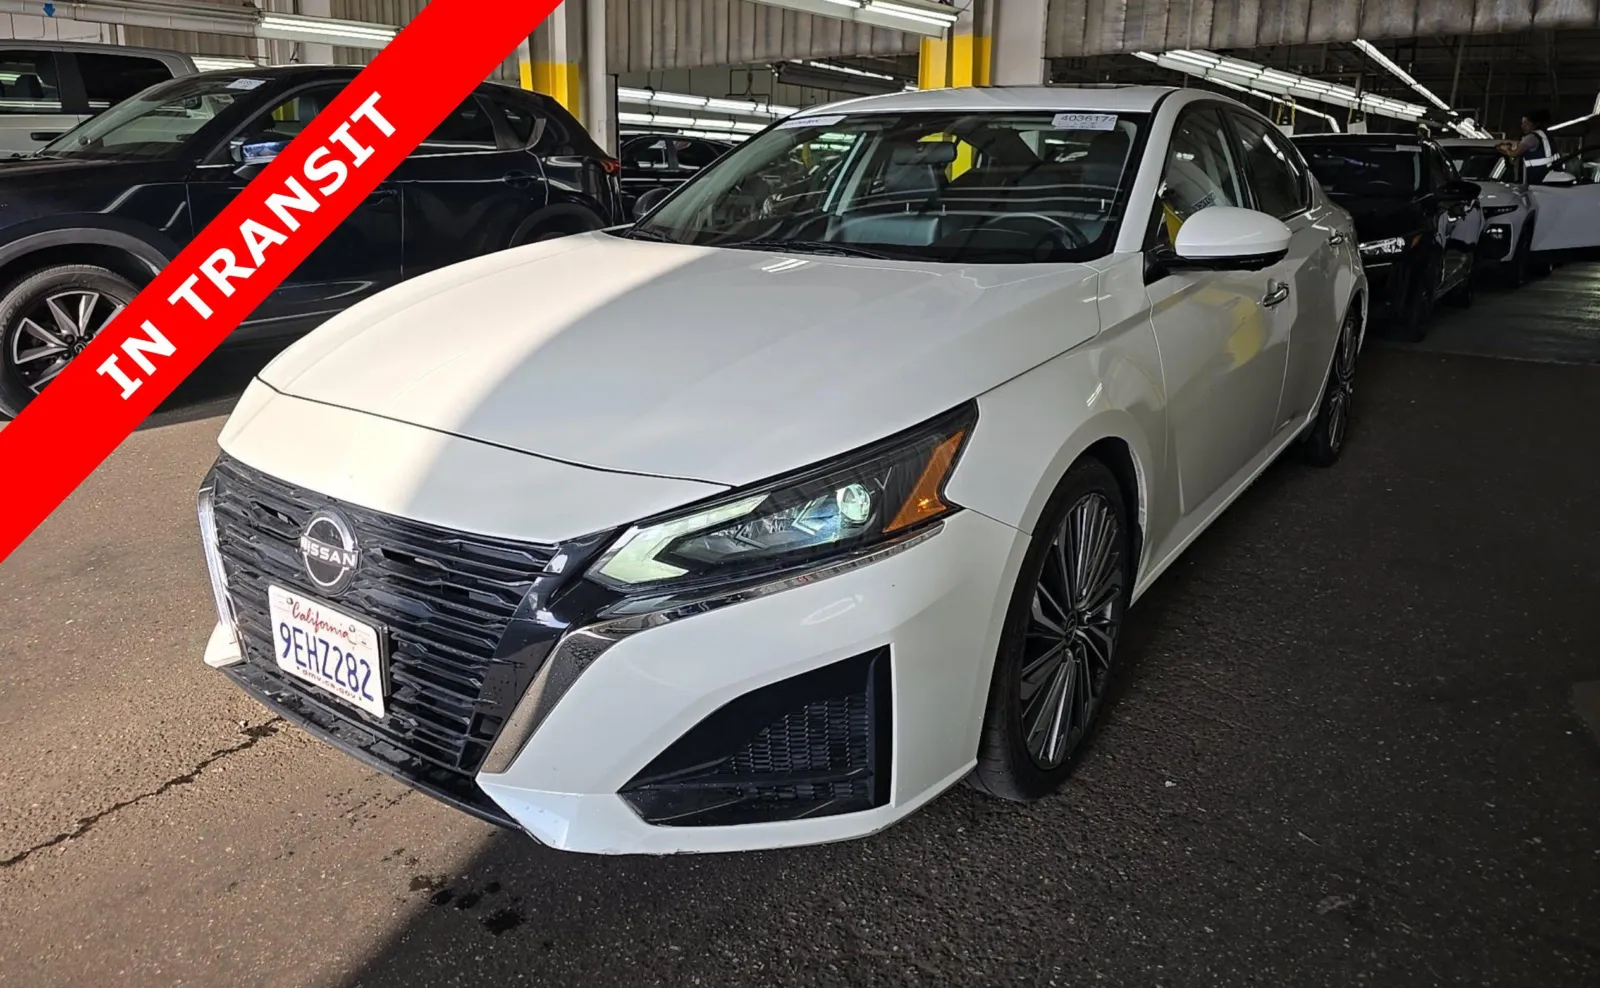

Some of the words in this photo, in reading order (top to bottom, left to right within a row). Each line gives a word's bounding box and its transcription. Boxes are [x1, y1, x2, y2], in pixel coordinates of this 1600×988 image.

[301, 537, 356, 567] NISSAN
[292, 601, 349, 638] California
[280, 622, 374, 702] 9EHZ282
[302, 669, 356, 700] dmv.ca.gov
